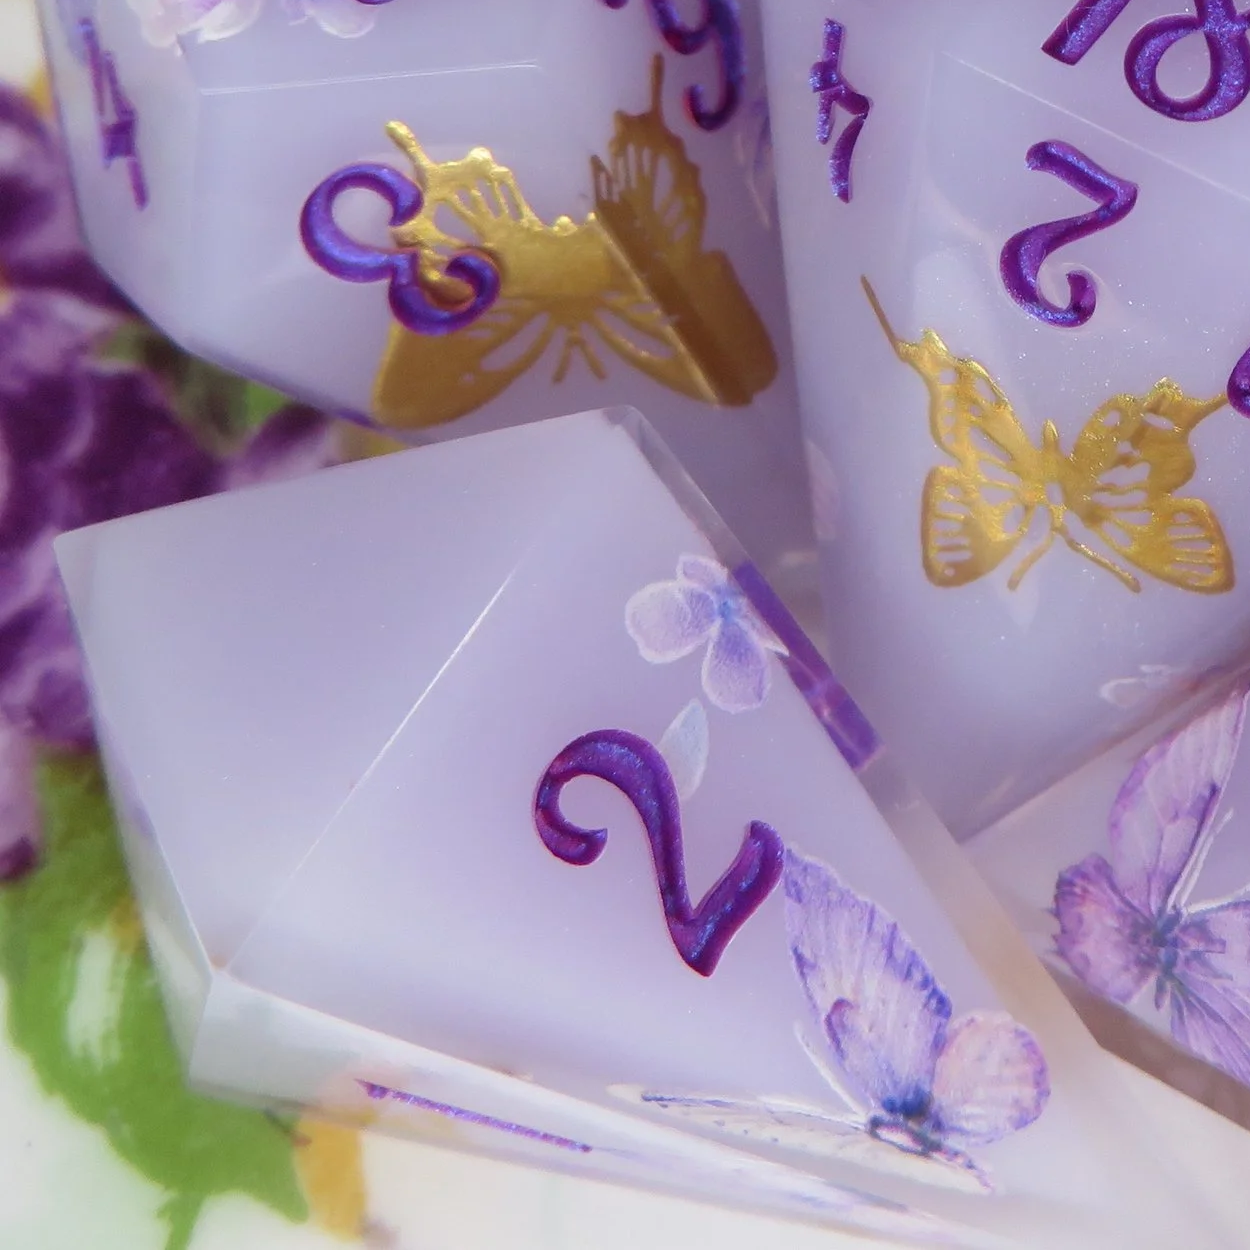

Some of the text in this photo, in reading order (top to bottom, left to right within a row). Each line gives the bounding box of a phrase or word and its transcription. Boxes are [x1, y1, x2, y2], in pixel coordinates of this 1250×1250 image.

[809, 17, 870, 203] 4
[300, 163, 500, 336] 3
[999, 139, 1138, 328] 2
[533, 728, 785, 978] 2
